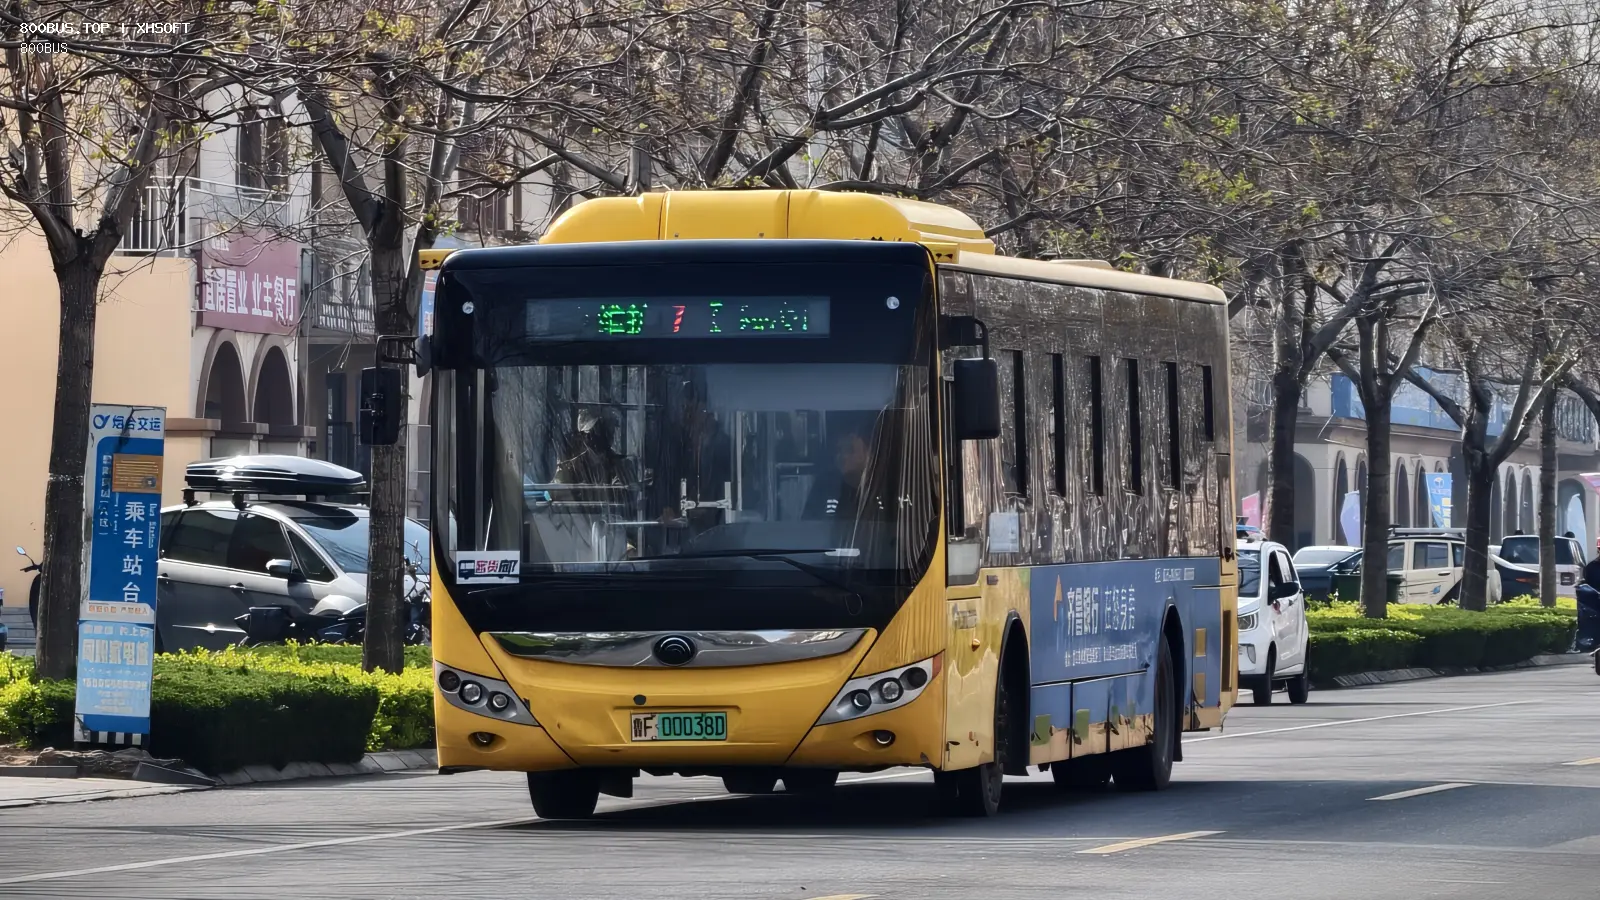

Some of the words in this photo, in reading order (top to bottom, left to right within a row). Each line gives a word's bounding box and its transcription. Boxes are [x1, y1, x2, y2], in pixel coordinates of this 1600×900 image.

[112, 414, 162, 432] 烟台交运
[121, 501, 146, 603] 乘车站台
